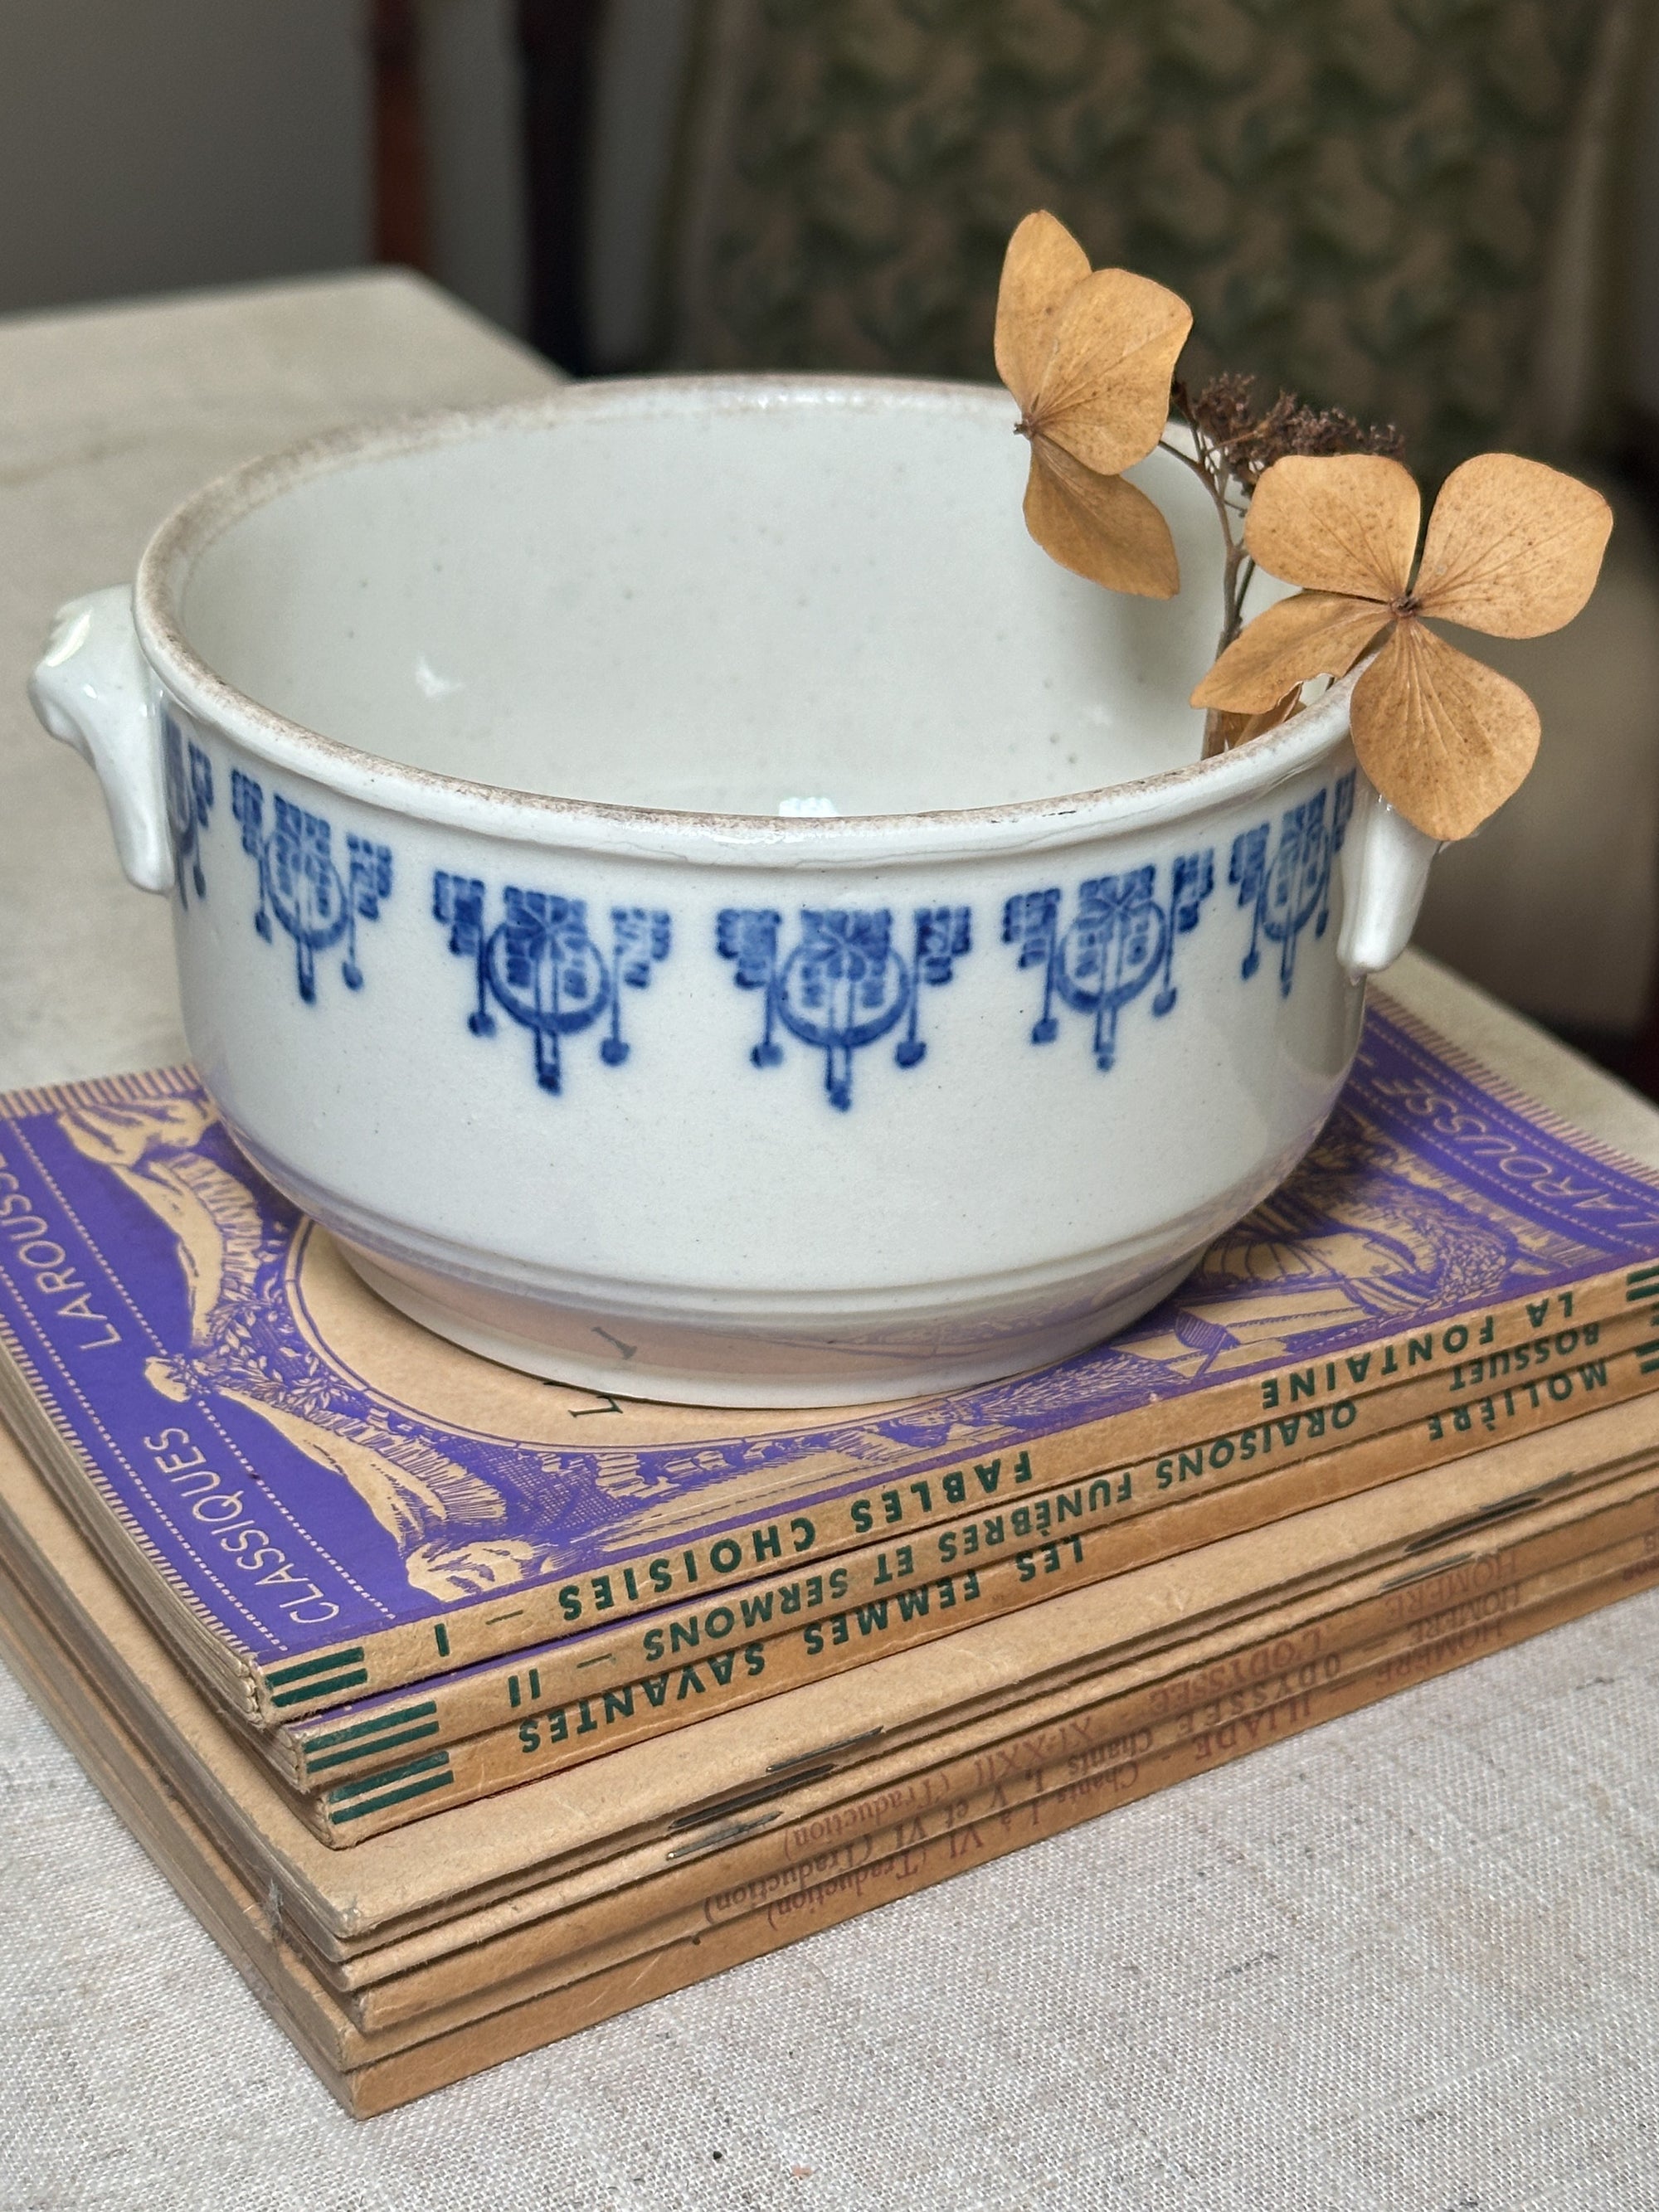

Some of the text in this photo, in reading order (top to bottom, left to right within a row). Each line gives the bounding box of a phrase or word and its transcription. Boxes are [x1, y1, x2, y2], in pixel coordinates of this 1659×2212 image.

[1527, 1291, 1574, 1328] LA
[0, 1153, 340, 1626] CLASSIQUES LAROUS
[1262, 1318, 1495, 1409] FONTAINE
[1448, 1323, 1600, 1392] BOSSUET
[1155, 1400, 1357, 1490] ORAISONS
[849, 1451, 1033, 1534] FABLES
[937, 1471, 1133, 1563] FUNÈBRES
[518, 1362, 1608, 1753] MOLIÈRE LES FEMMES SAVANTES
[558, 1517, 816, 1621] CHOISIES
[874, 1546, 914, 1586] ET
[433, 1623, 450, 1657] I
[643, 1567, 847, 1662] SERMONS
[508, 1669, 541, 1708] II
[1067, 1728, 1154, 1777] Chants
[1194, 1696, 1311, 1762] ILIADE
[784, 1771, 951, 1861] (Traduction)
[945, 1797, 970, 1825] et
[1056, 1761, 1139, 1805] Chants
[894, 1816, 929, 1850] VI
[947, 1823, 985, 1859] VI
[704, 1833, 876, 1924] (Traduction)
[767, 1848, 927, 1931] (Traduction)
